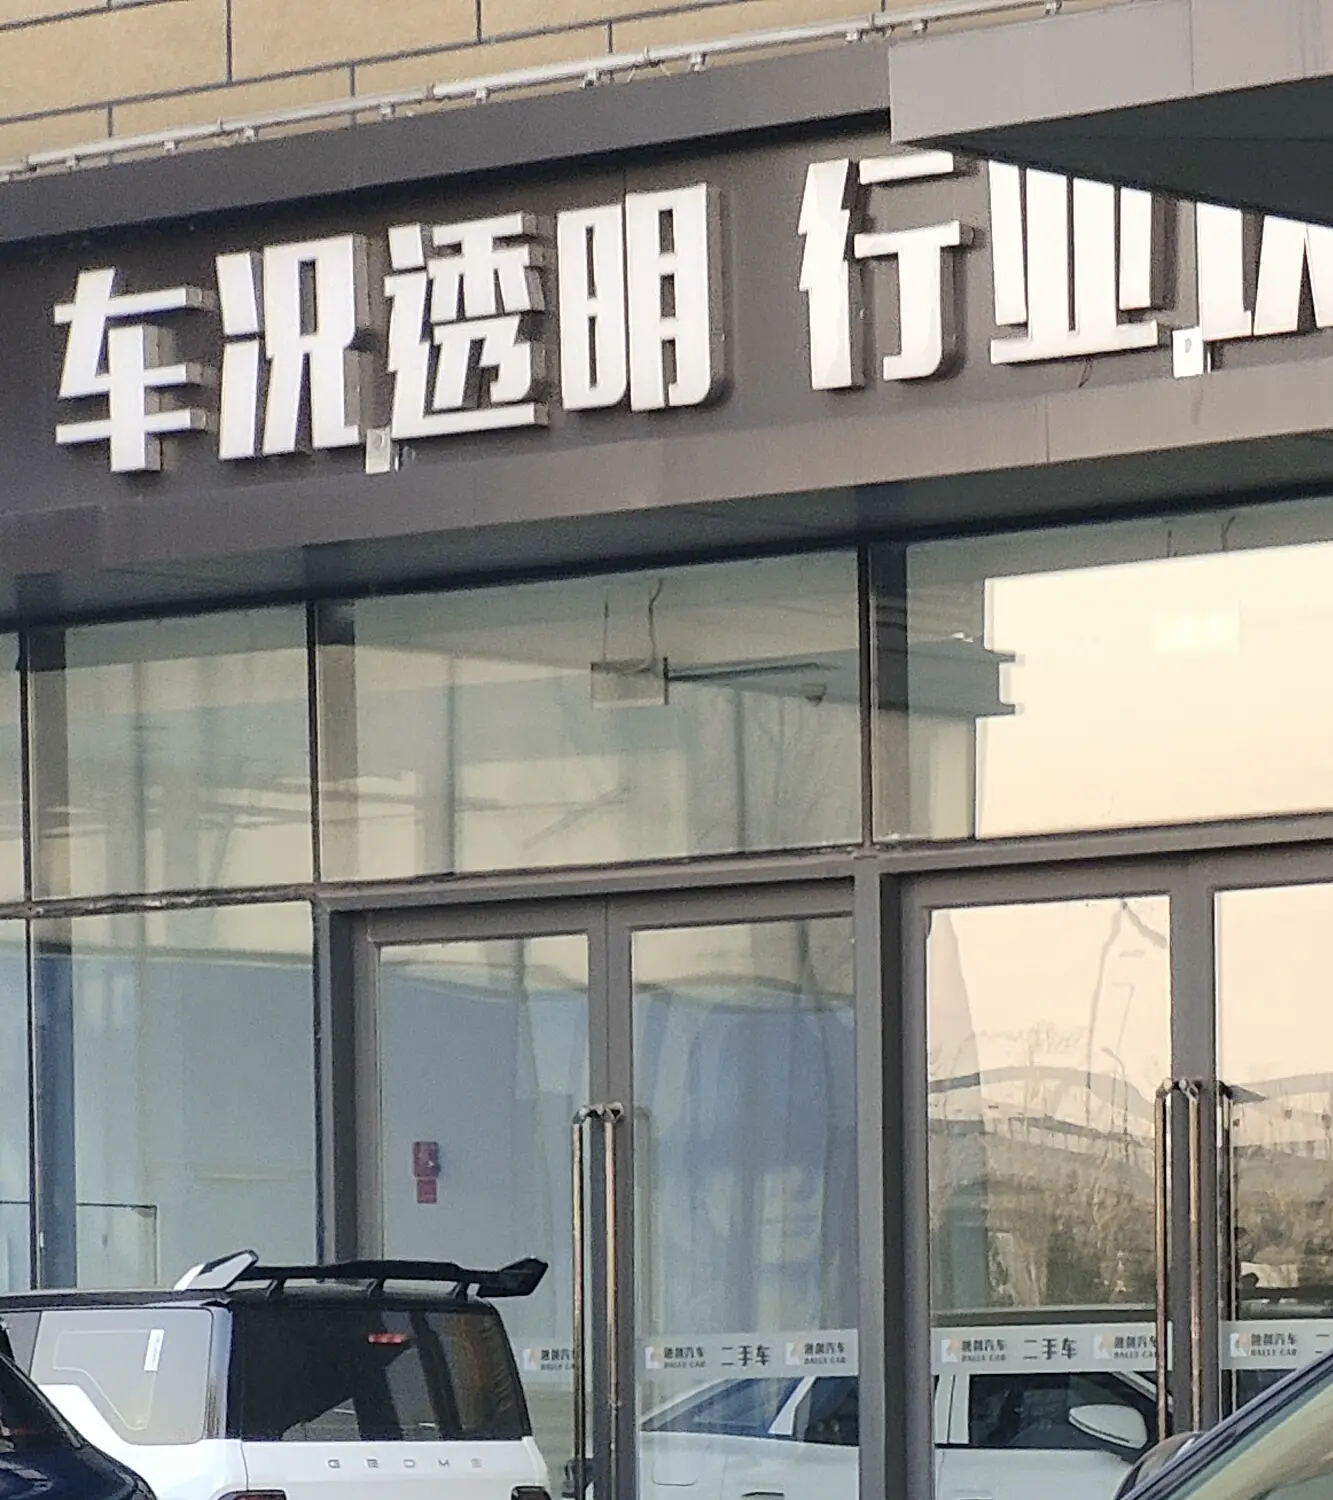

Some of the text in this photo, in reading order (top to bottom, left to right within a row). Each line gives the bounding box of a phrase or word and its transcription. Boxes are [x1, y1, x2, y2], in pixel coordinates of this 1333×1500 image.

[54, 182, 714, 473] 车况透明
[721, 1344, 770, 1367] 二手车
[1023, 1337, 1077, 1360] 二手车
